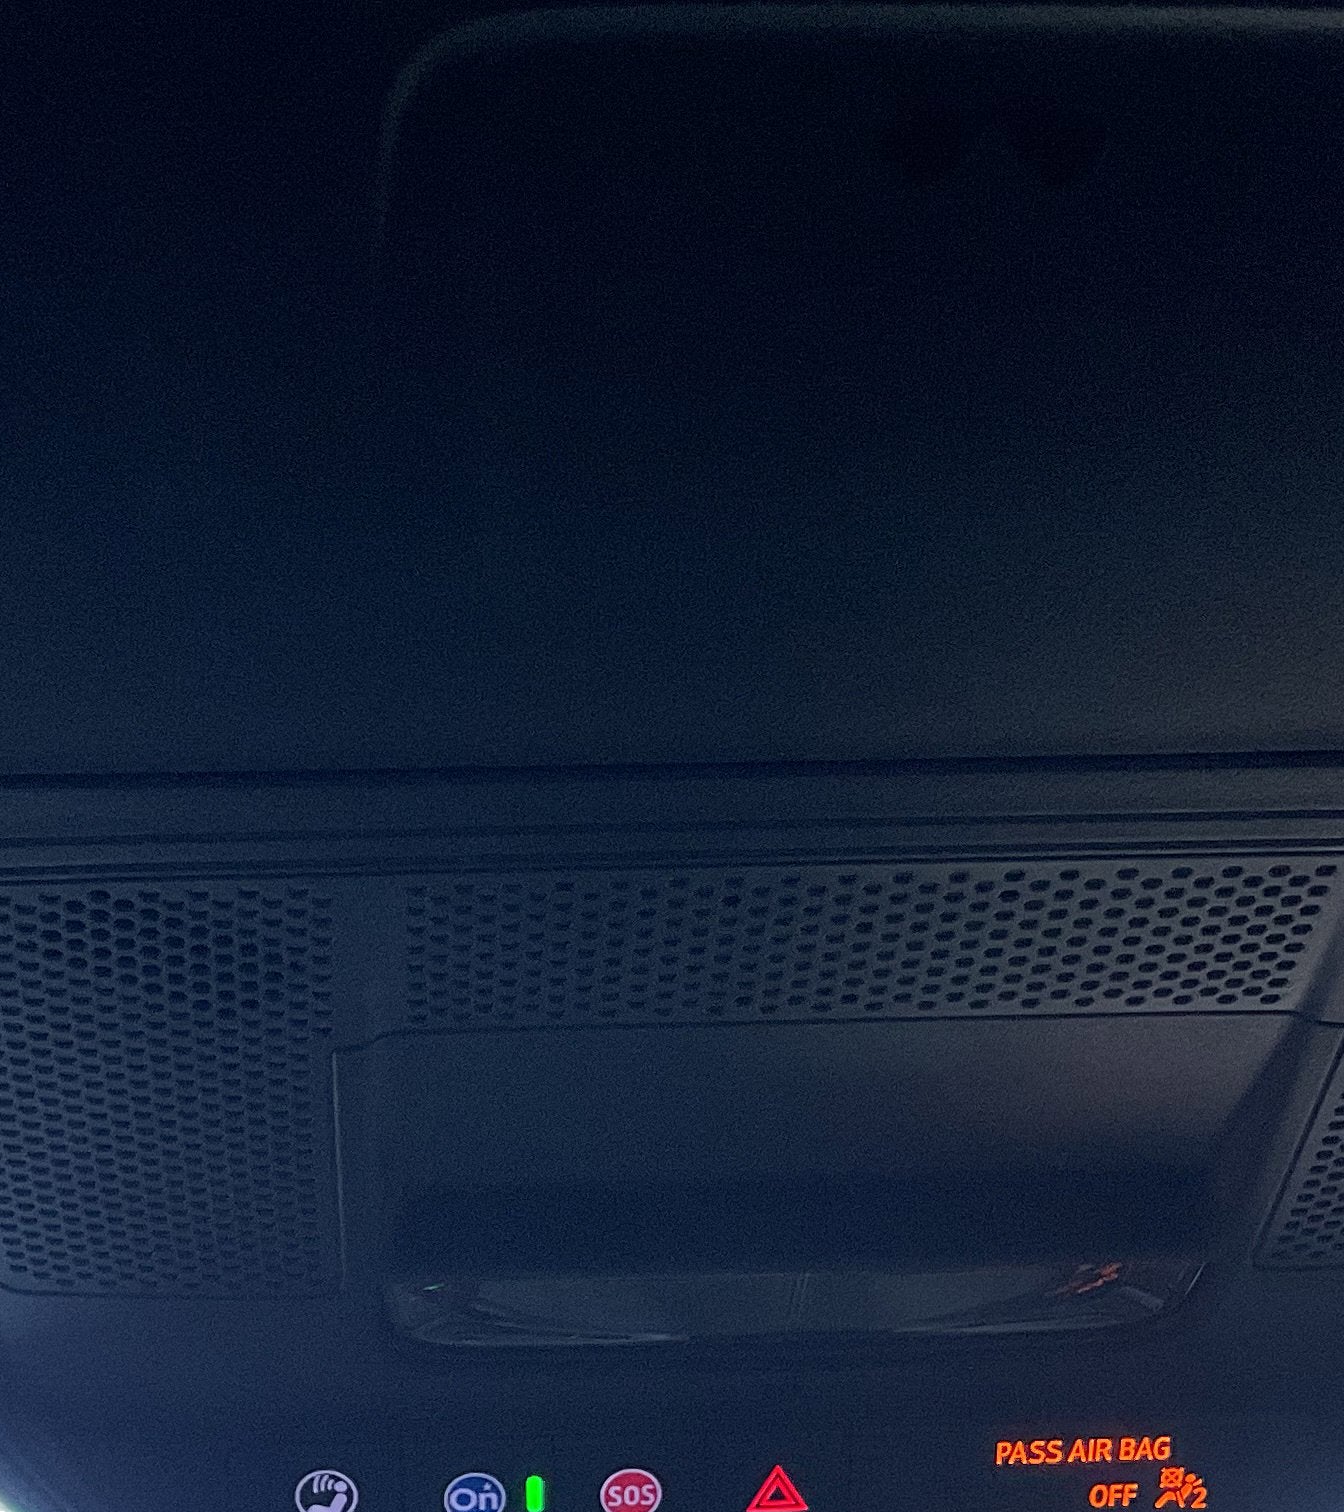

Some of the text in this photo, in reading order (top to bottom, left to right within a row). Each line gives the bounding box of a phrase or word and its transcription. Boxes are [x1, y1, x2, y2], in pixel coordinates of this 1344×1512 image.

[995, 1436, 1171, 1465] PASS AIR BAG
[450, 1484, 499, 1511] On
[607, 1484, 655, 1507] SOS
[1088, 1483, 1138, 1508] OFF
